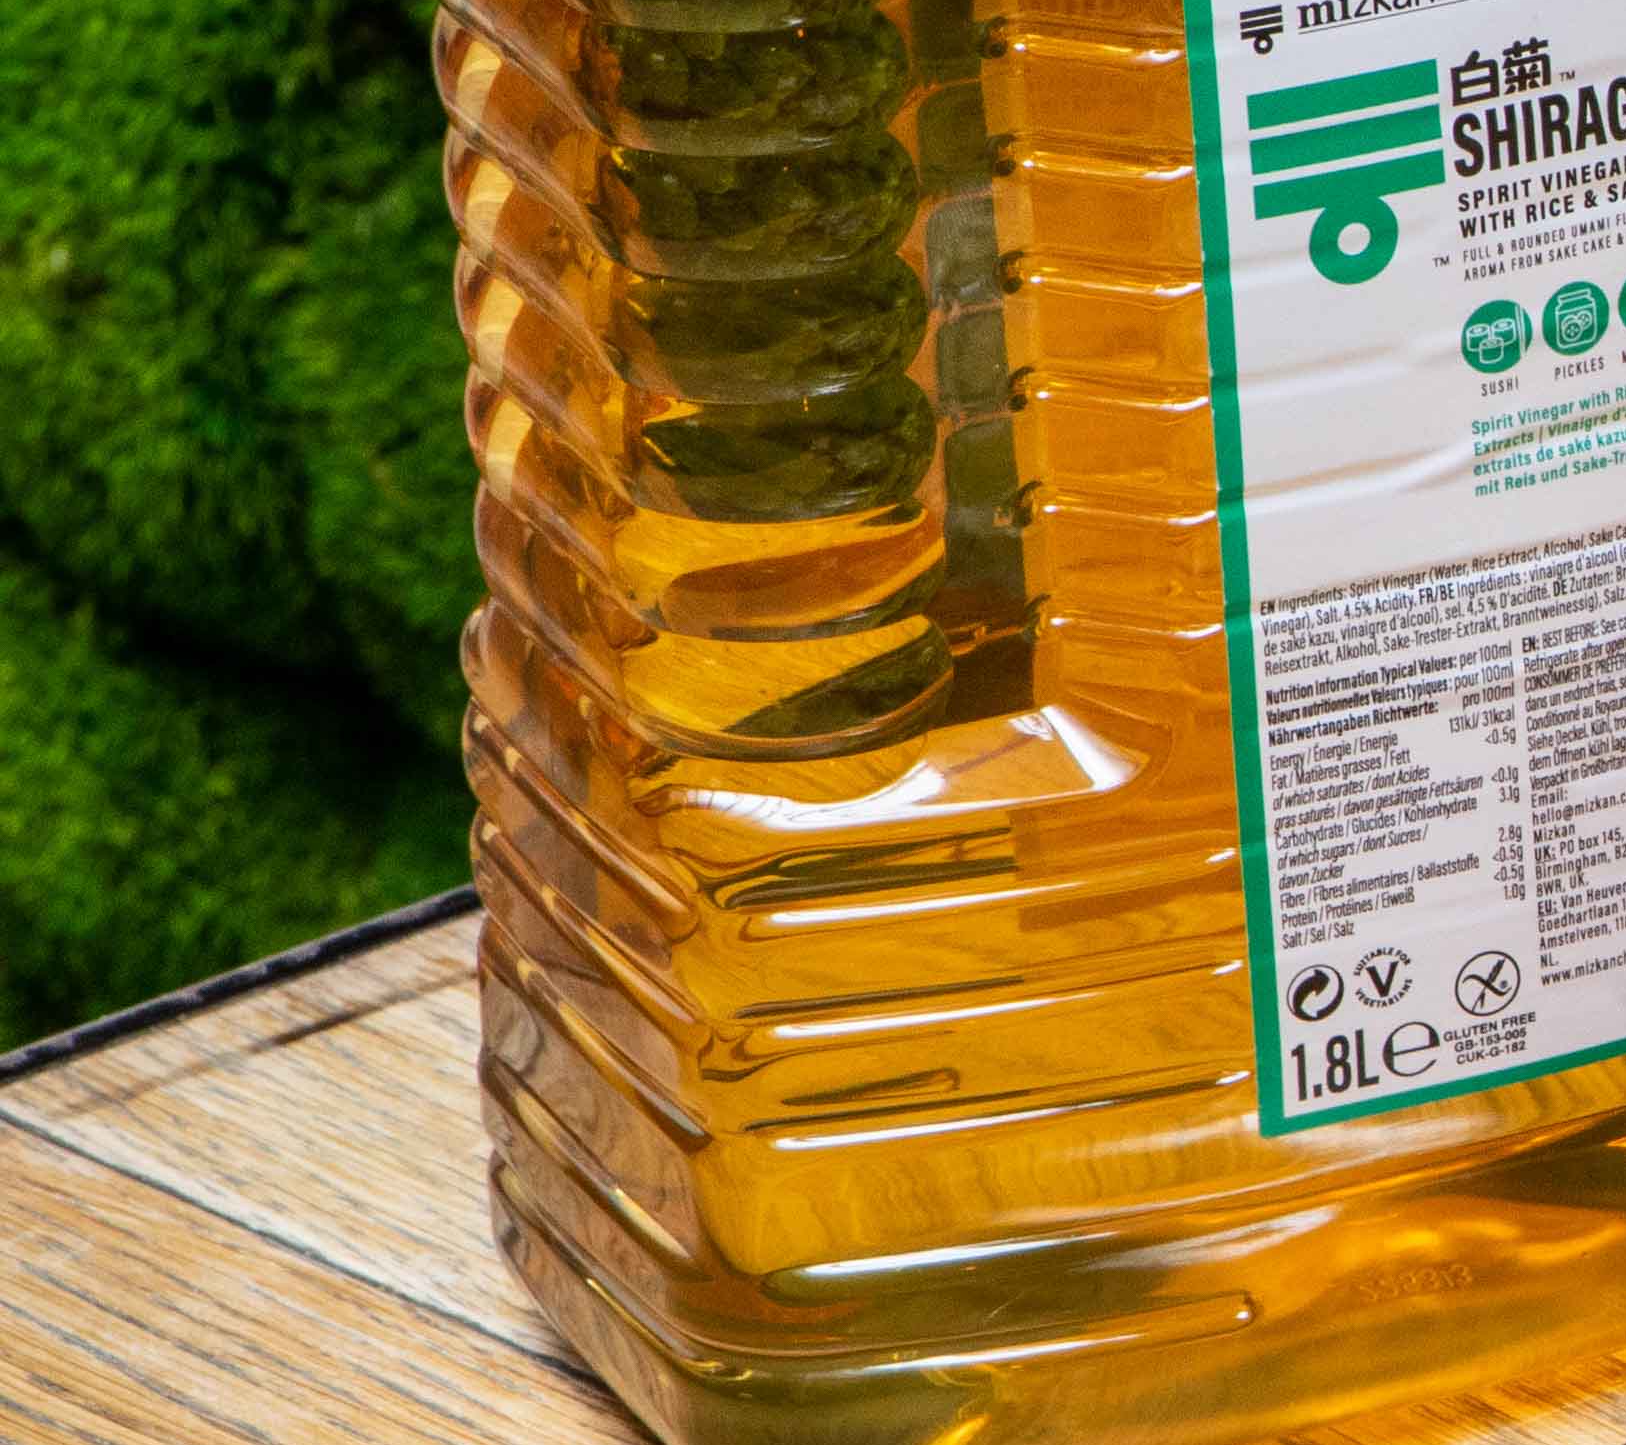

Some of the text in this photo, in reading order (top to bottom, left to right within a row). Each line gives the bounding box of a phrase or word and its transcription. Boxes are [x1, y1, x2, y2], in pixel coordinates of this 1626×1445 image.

[1450, 36, 1552, 107] 白菊
[1458, 178, 1532, 213] SPIRIT
[1459, 208, 1516, 239] WITH
[1525, 193, 1575, 224] RICE
[1583, 189, 1599, 209] &
[1463, 245, 1491, 263] FULL
[1496, 242, 1505, 256] &
[1510, 227, 1566, 252] ROUNDED
[1571, 217, 1610, 238] UMAMI
[1464, 260, 1506, 282] AROMA
[1511, 252, 1543, 271] FROM
[1548, 243, 1577, 263] SAKE
[1582, 234, 1611, 254] CAKE
[1616, 232, 1624, 246] &
[1480, 375, 1519, 398] SUSHI
[1554, 355, 1605, 380] PICKLES
[1471, 414, 1514, 437] Spirit
[1517, 401, 1575, 426] Vinegar
[1578, 390, 1611, 411] with
[1473, 431, 1535, 457] Extracts
[1547, 413, 1609, 439] Vinaigre
[1473, 452, 1532, 476] extraits
[1535, 445, 1554, 463] de
[1558, 434, 1593, 458] saké
[1475, 479, 1500, 497] mit
[1504, 472, 1537, 491] Reis
[1540, 462, 1568, 483] und
[1259, 599, 1276, 617] EN
[1277, 586, 1348, 614] Ingredients:
[1349, 578, 1381, 600] Spirit
[1381, 570, 1428, 592] Vinegar
[1428, 562, 1470, 584] (Water,
[1471, 556, 1497, 573] Rice
[1497, 546, 1542, 569] Extract,
[1543, 533, 1587, 559] Alcohol,
[1587, 528, 1614, 548] Sake
[1261, 612, 1315, 638] Vinegar),
[1315, 606, 1342, 627] Salt.
[1343, 600, 1373, 620] 4.5%
[1374, 593, 1417, 615] Acidity.
[1418, 582, 1456, 606] FR/BE
[1456, 570, 1522, 599] Ingrédients
[1528, 560, 1574, 583] vinaigre
[1575, 545, 1618, 573] d'alcool
[1263, 640, 1278, 658] de
[1279, 633, 1307, 654] saké
[1307, 630, 1339, 648] kazu,
[1339, 619, 1389, 642] vinaigre
[1388, 607, 1443, 635] d'alcool),
[1444, 602, 1465, 621] sel.
[1499, 584, 1551, 610] D'acidité.
[1552, 578, 1568, 598] DE
[1569, 570, 1614, 594] Zutaten:
[1264, 649, 1334, 677] Reisextrakt,
[1335, 637, 1382, 663] Alkohol,
[1383, 615, 1501, 654] Sake-Trester-Extrakt,
[1502, 590, 1603, 629] Branntweinessig),
[1265, 640, 1513, 706] Nutrition Information Typical Values: per 100ml
[1268, 680, 1515, 748] Nährwertangaben Richtwerte: pro 100ml
[1530, 786, 1568, 809] Email:
[1533, 823, 1576, 844] Mizkan
[1534, 826, 1625, 865] UK: PO box 145,
[1569, 871, 1589, 890] UK.
[1537, 898, 1559, 918] EU:
[1560, 893, 1583, 910] Van
[1540, 952, 1559, 968] NL.
[1442, 1011, 1537, 1043] GLUTEN FREE
[1454, 1023, 1528, 1057] GB-153-005
[1290, 1028, 1380, 1102] 1.8L
[1455, 1039, 1526, 1066] CUK-G-182
